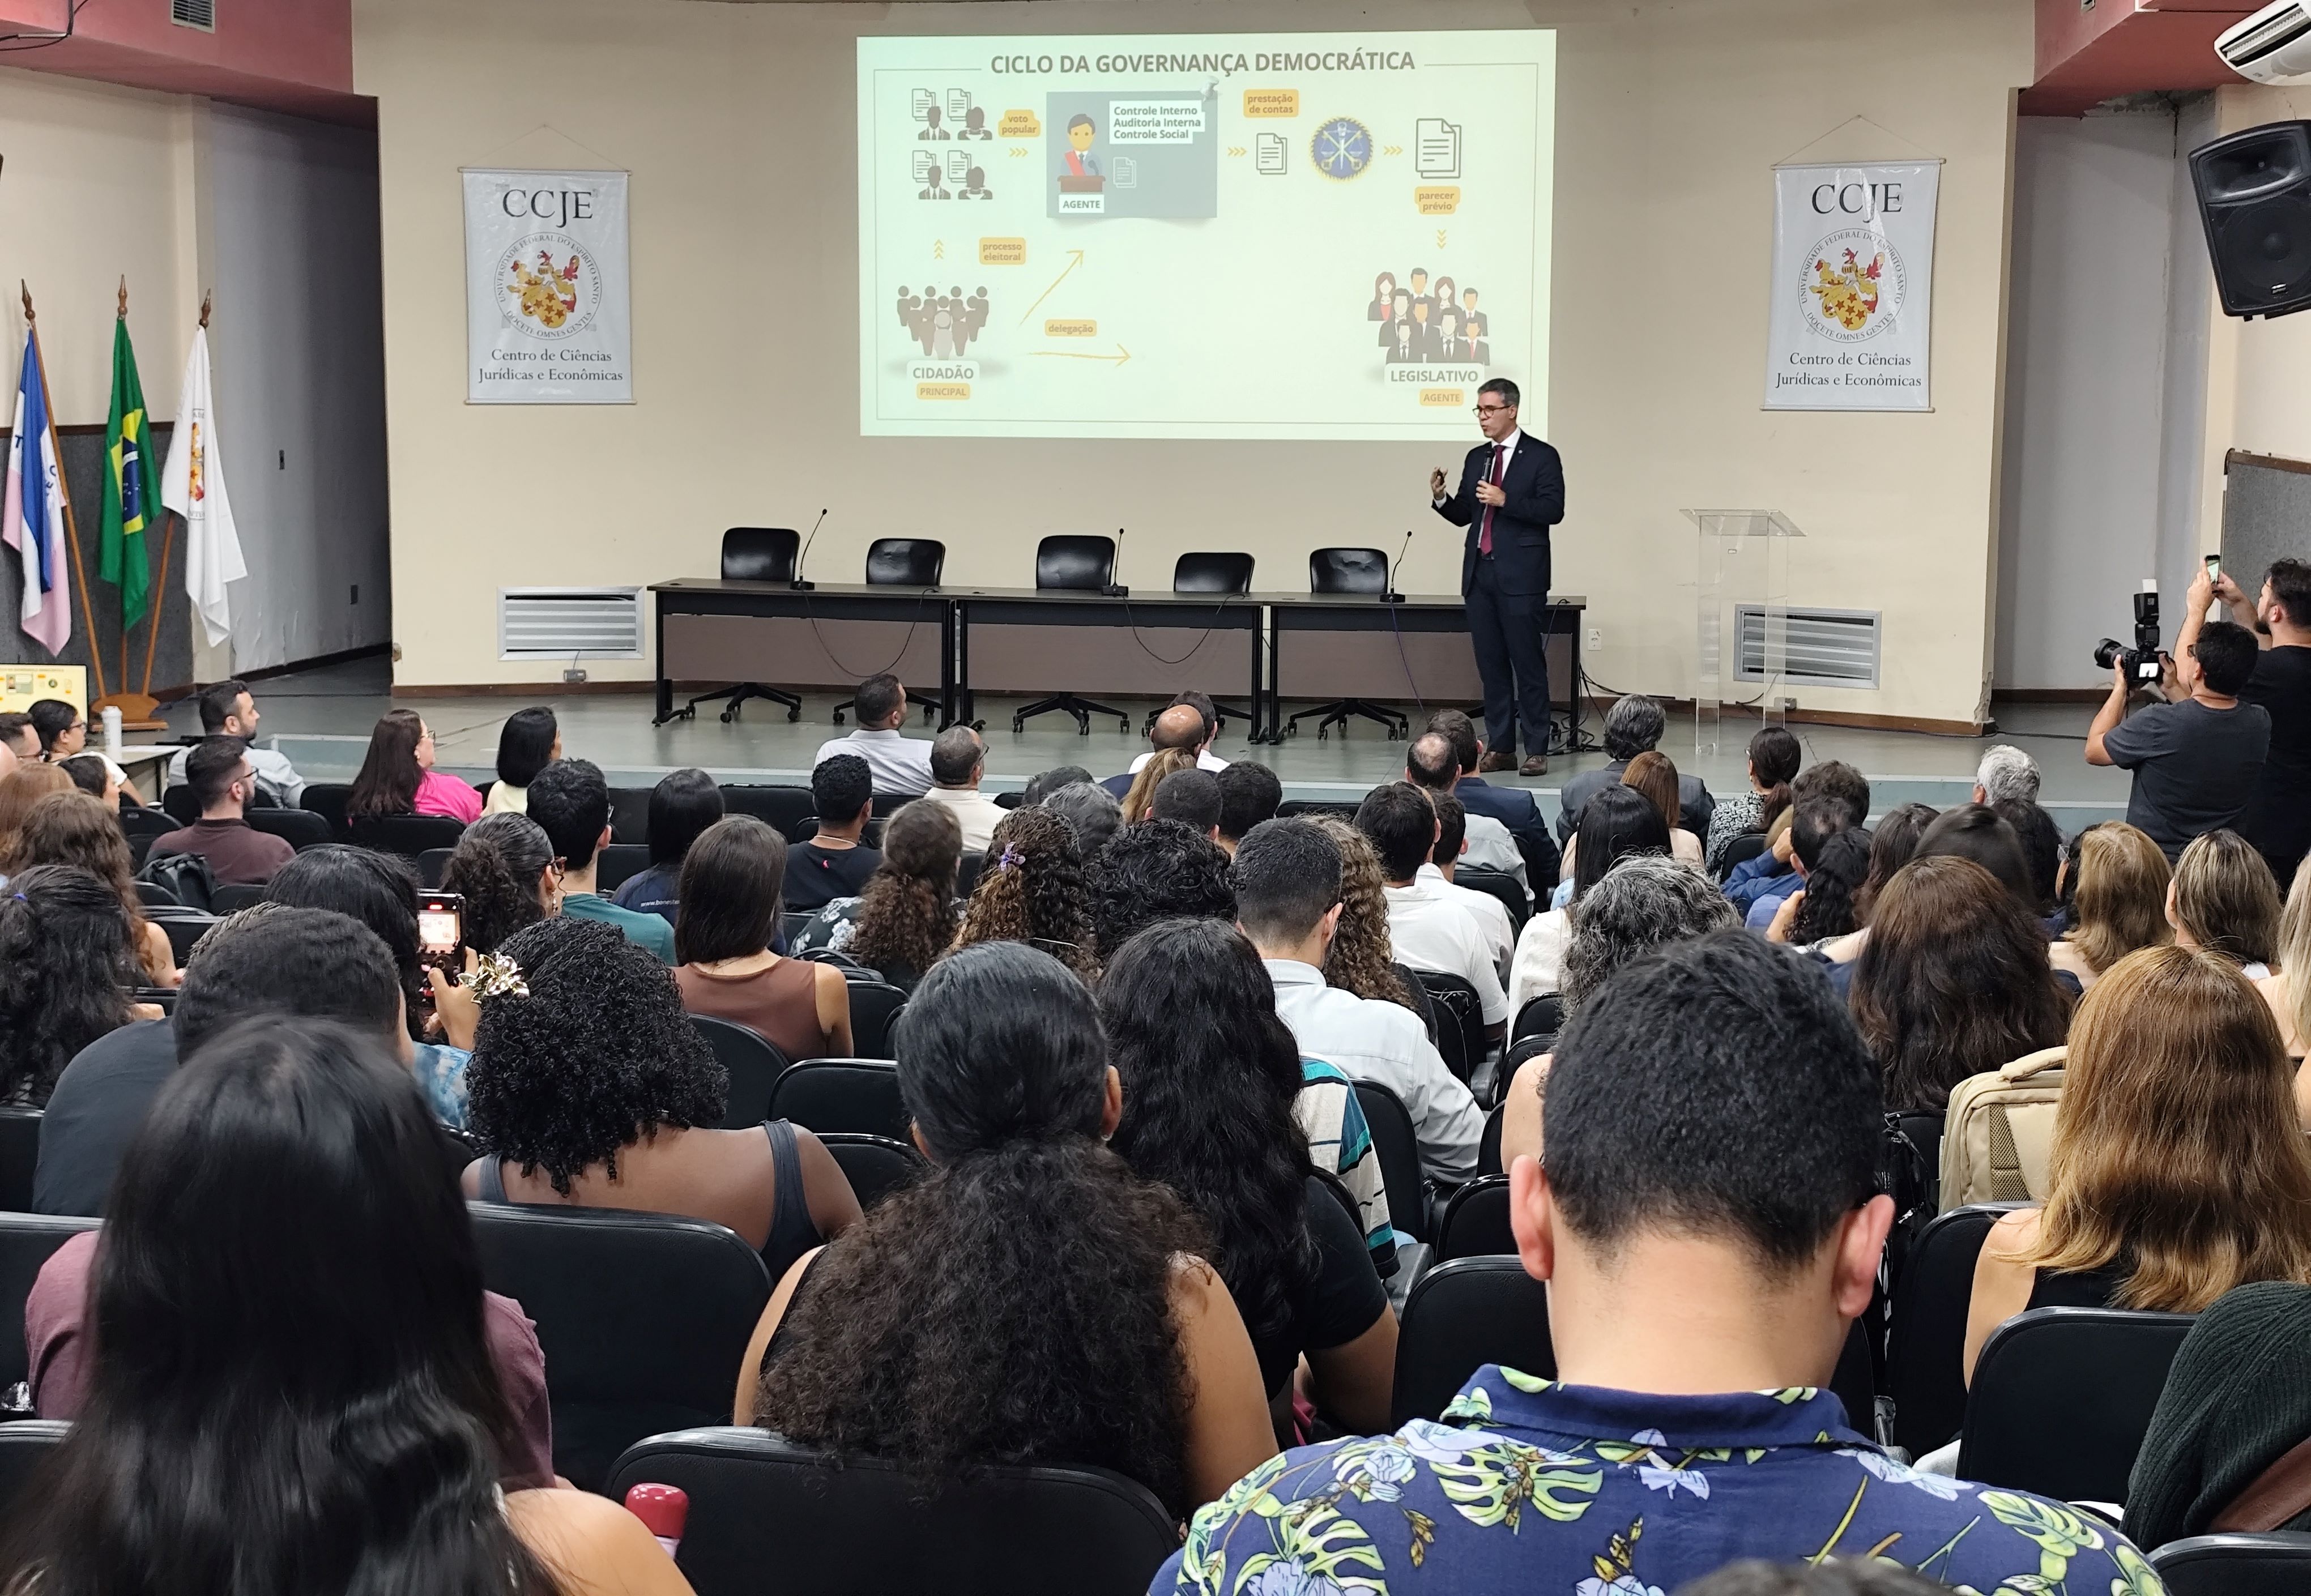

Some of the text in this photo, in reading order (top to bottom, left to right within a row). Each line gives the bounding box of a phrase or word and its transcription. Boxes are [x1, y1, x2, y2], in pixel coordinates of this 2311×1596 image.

[991, 47, 1415, 76] CICLO DA GOVERNANÇA DEMOCRÁTICA
[1247, 94, 1293, 105] prestação
[1114, 106, 1198, 116] Controle Interno
[1249, 105, 1294, 114] de contas
[1114, 118, 1201, 127] Auditoria Interna
[1001, 125, 1037, 136] popular
[1114, 129, 1189, 139] Controle Social
[1418, 191, 1455, 202] parecer
[502, 189, 593, 228] CCJE
[1063, 200, 1101, 209] AGENTE
[1422, 201, 1452, 212] prévio
[1812, 183, 1902, 223] CCJE
[983, 243, 1022, 252] processo
[983, 252, 1021, 261] eleitoral
[519, 234, 556, 249] FEDERAL
[557, 236, 570, 246] DO
[591, 275, 600, 304] SANTO
[1800, 244, 1825, 304] UNIVERSIDADE
[1824, 231, 1861, 246] FEDERAL
[1863, 232, 1877, 242] DO
[1894, 272, 1904, 304] SANTO
[1048, 324, 1093, 335] delegação
[1807, 311, 1894, 341] DOCETE OMNES GENTES
[491, 348, 612, 361] Centro de Ciências
[1790, 352, 1911, 365] Centro de Ciências
[478, 368, 534, 383] Jurídicas
[549, 368, 623, 381] Econômicas
[913, 364, 974, 380] CIDADÃO
[1391, 370, 1478, 382] LEGISLATIVO
[1775, 372, 1829, 388] Jurídicas
[1845, 373, 1922, 387] Econômicas
[920, 387, 966, 396] PRINCIPAL
